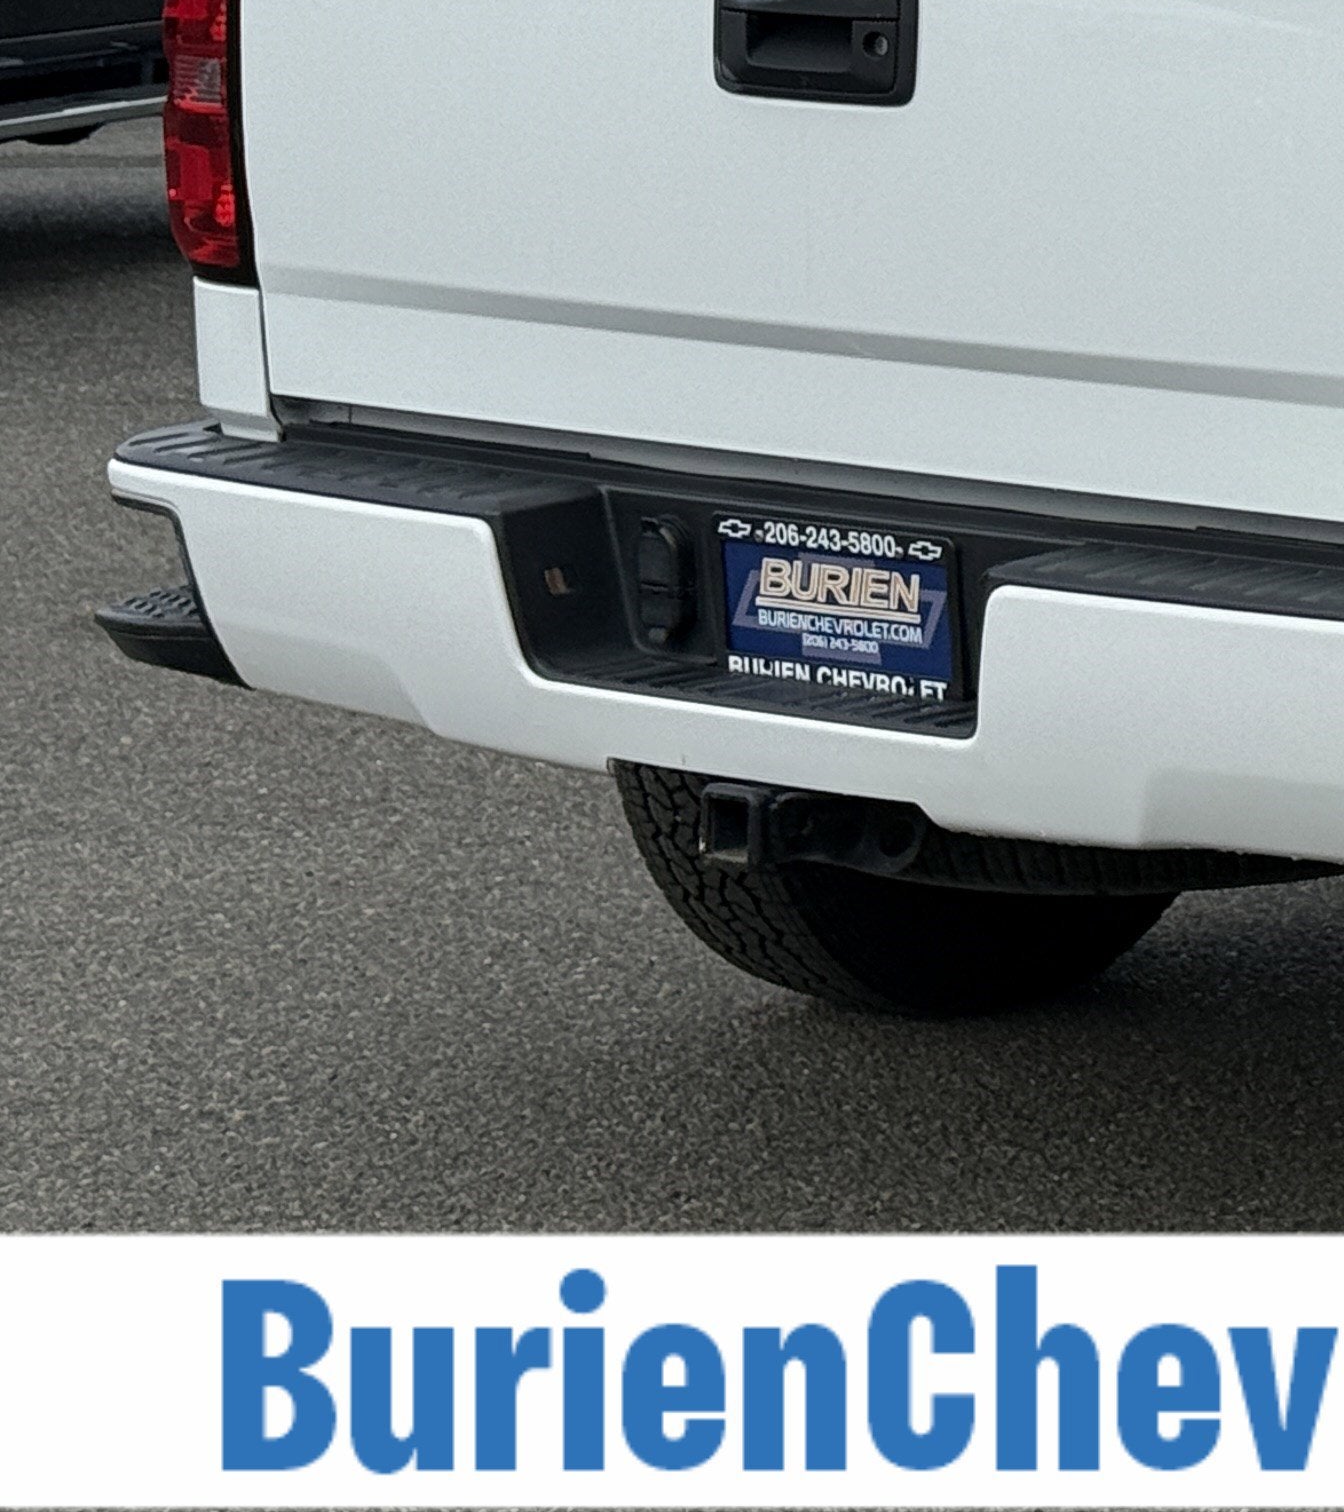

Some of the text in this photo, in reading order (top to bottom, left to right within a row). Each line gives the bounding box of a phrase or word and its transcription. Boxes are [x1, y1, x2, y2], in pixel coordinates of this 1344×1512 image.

[759, 556, 920, 613] BURIEN
[758, 608, 923, 643] BURIENCHEVROLET.COM
[816, 665, 948, 702] CHEVROET
